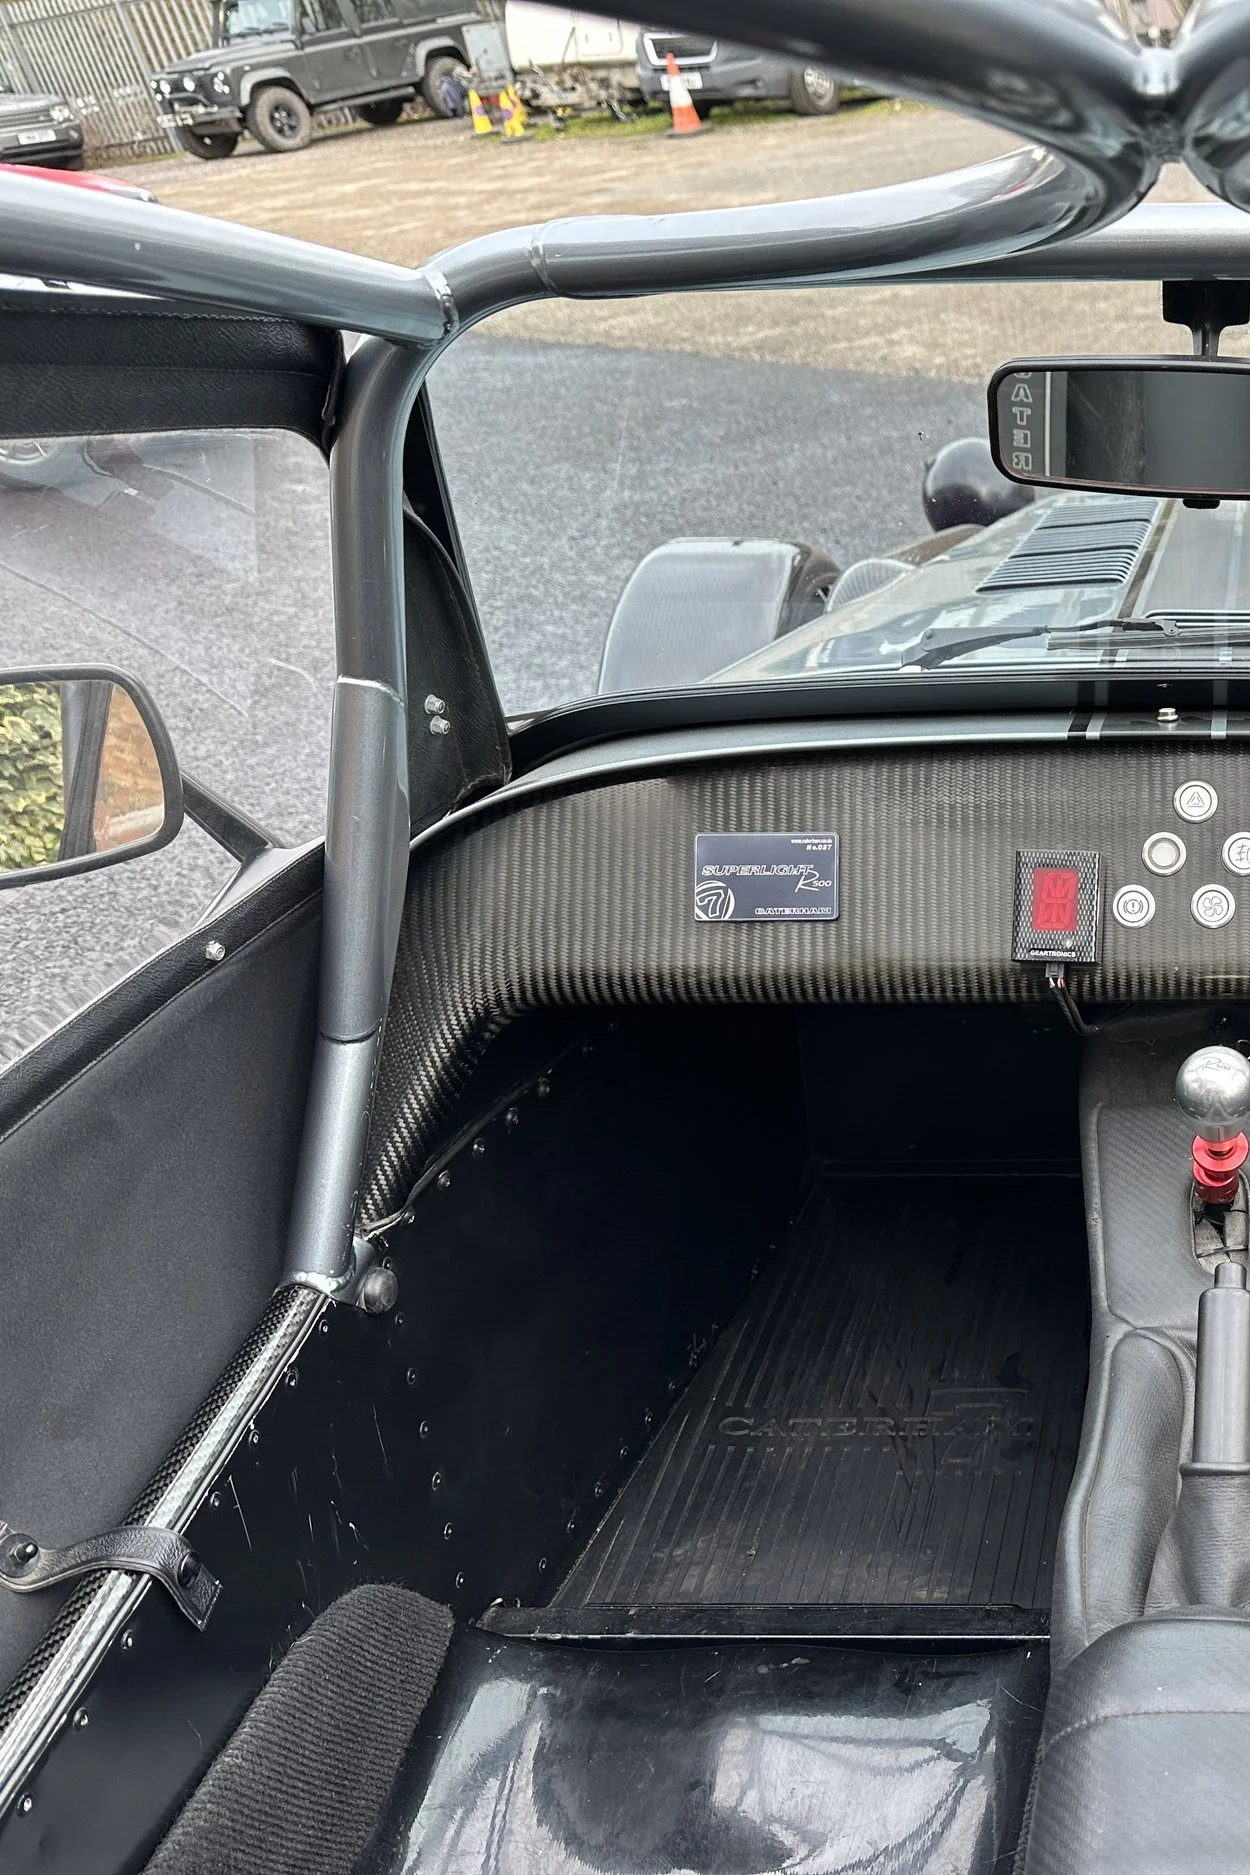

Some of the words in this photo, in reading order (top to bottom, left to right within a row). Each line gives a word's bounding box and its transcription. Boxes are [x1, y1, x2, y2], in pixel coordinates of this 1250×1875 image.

[701, 864, 814, 876] SUPERLIGHT
[794, 870, 833, 893] R500
[754, 907, 832, 915] CATERHAM
[1029, 949, 1076, 958] GEARTRONICS
